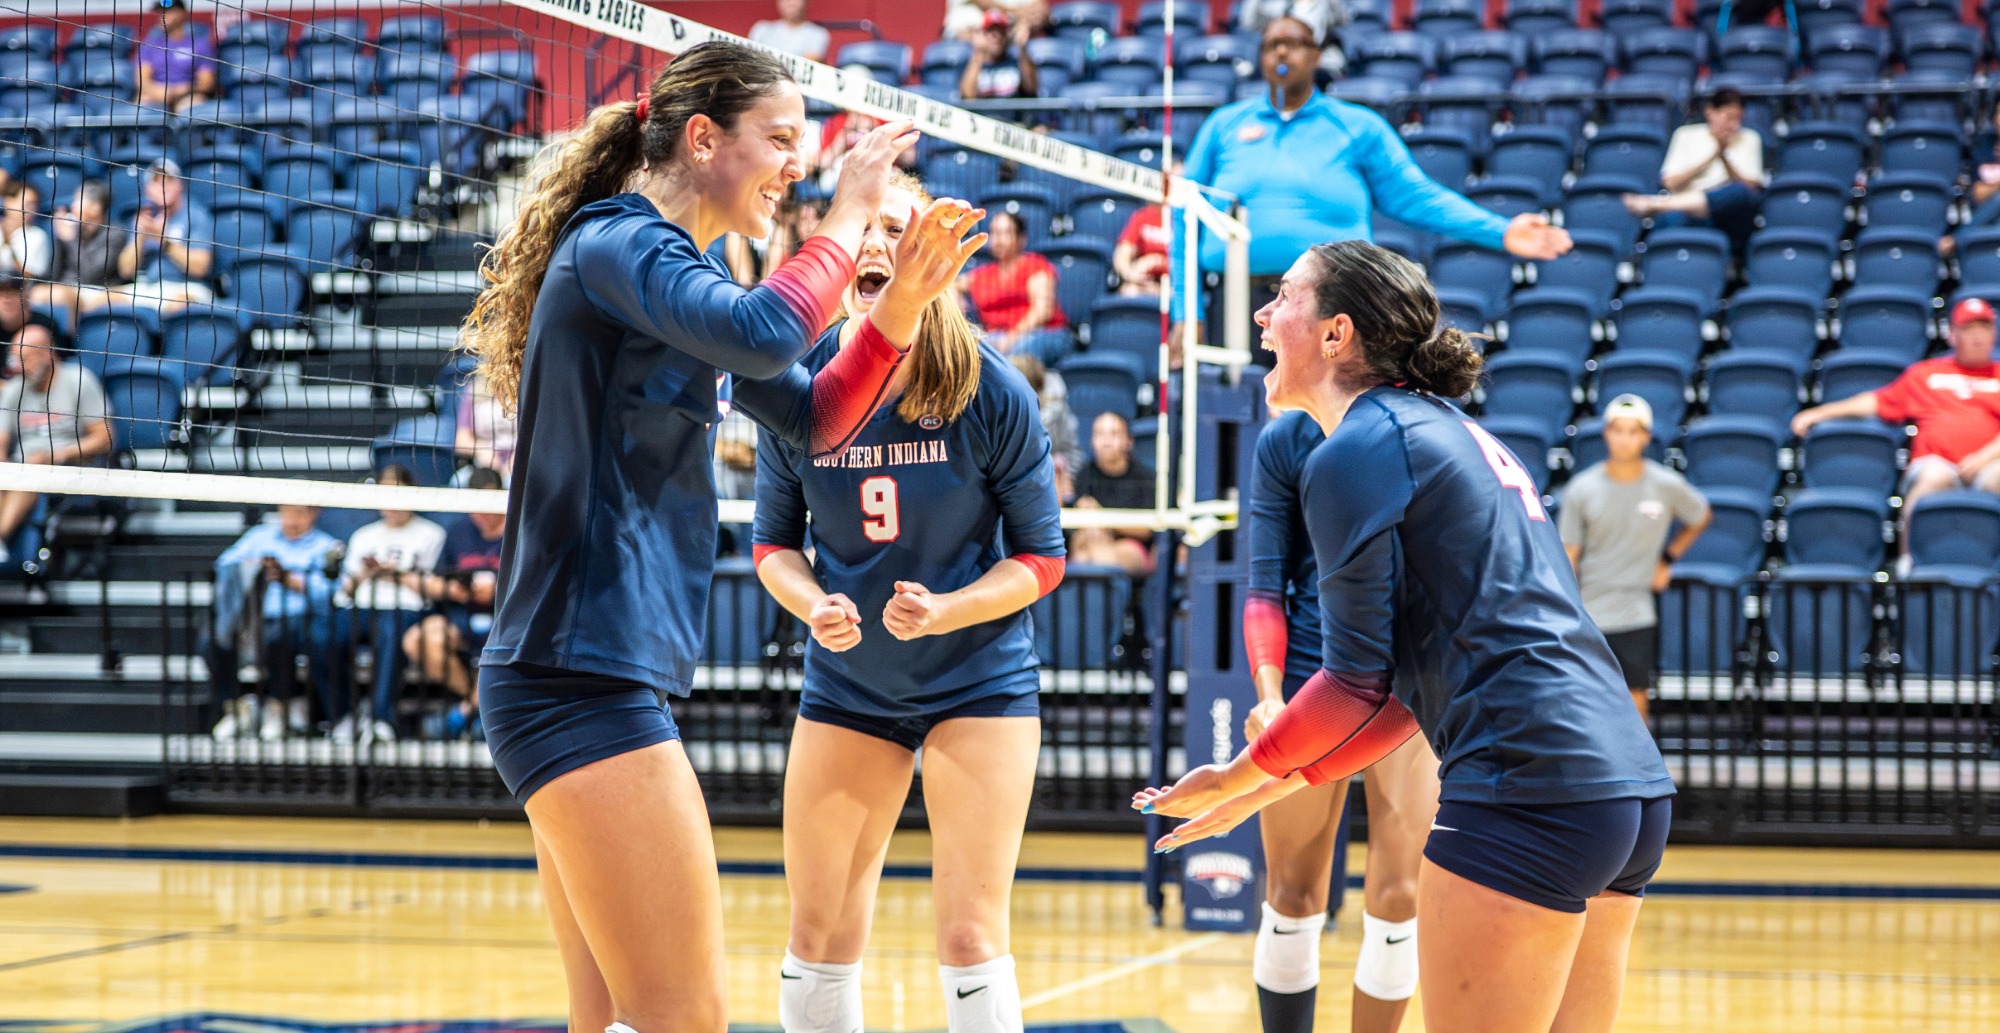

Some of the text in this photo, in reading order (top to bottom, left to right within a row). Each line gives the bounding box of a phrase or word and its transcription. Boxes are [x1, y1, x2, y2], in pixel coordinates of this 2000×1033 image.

[597, 0, 646, 32] EAGLES
[888, 440, 948, 466] INDIANA
[1461, 419, 1547, 523] 4
[860, 475, 900, 543] 9
